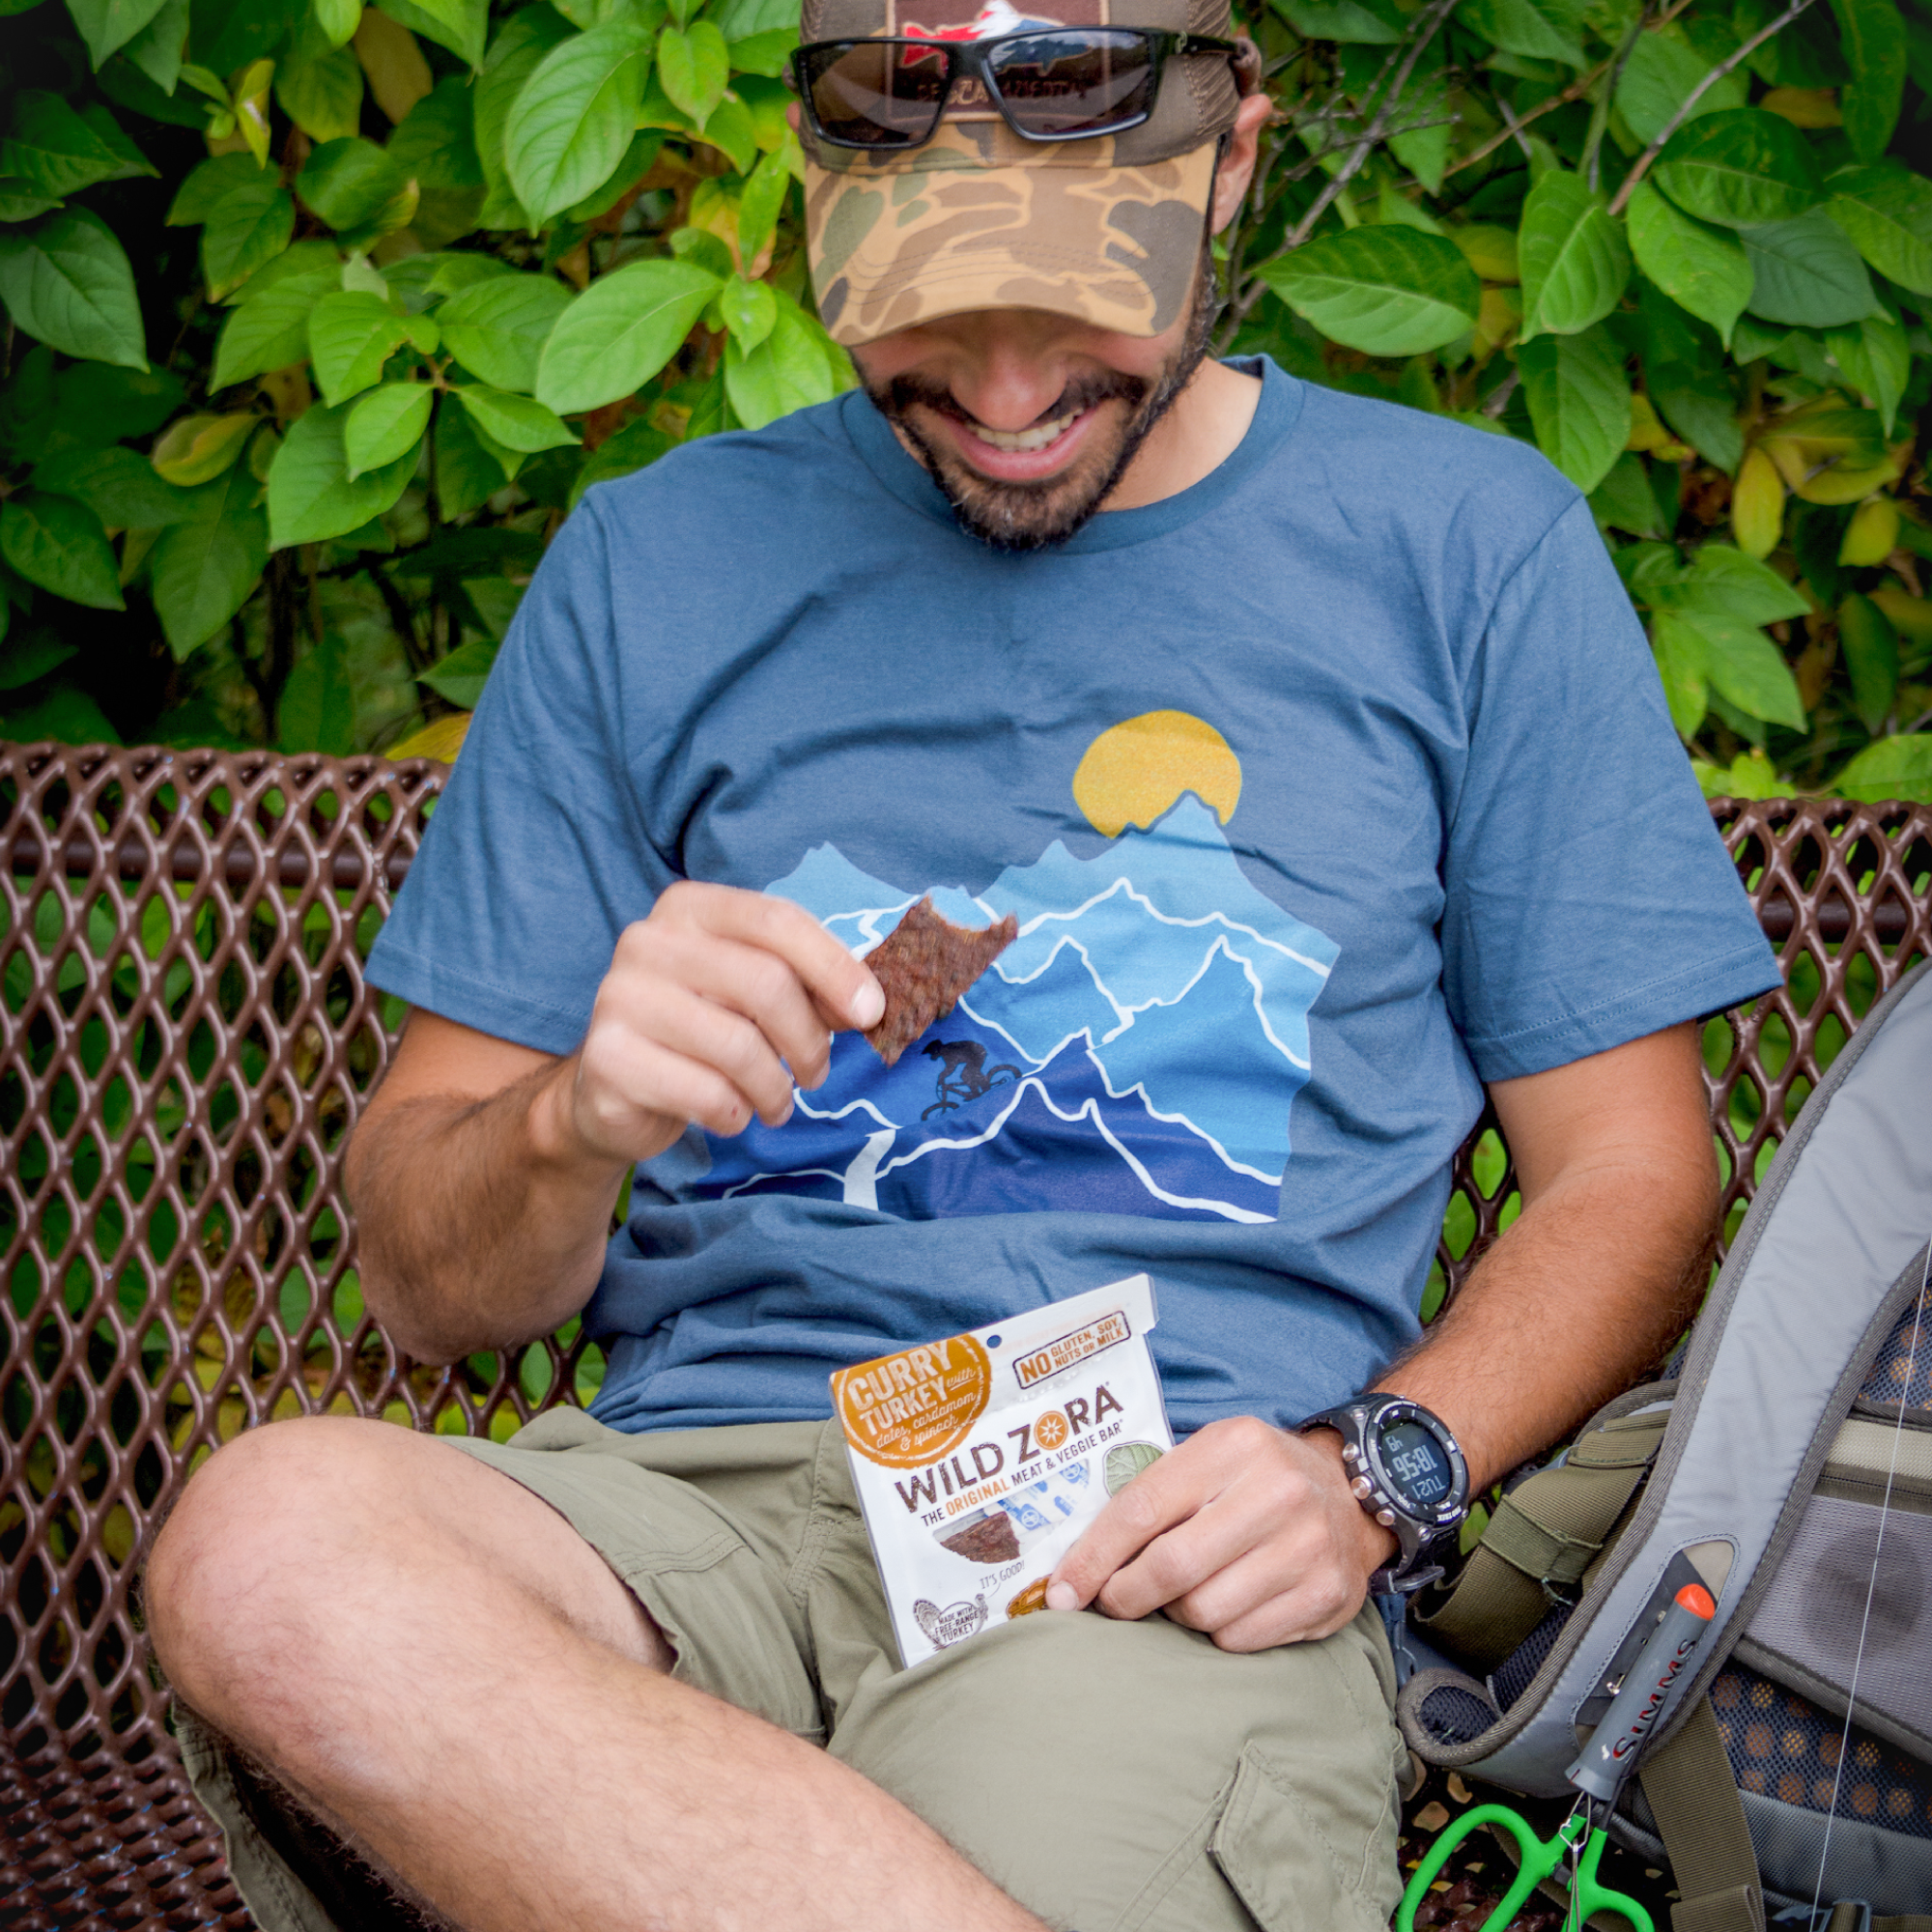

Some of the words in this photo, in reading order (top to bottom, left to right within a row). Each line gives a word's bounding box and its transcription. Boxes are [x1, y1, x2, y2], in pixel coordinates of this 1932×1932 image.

[1054, 1348, 1082, 1368] NUTS
[1083, 1342, 1095, 1353] OR
[1097, 1326, 1123, 1347] MILK
[848, 1340, 952, 1411] CURRY
[1019, 1352, 1052, 1383] NO
[859, 1376, 948, 1436] TURKEY
[947, 1367, 977, 1388] with
[877, 1426, 911, 1449] dates,
[913, 1392, 977, 1430] cardamom
[895, 1441, 1004, 1514] WILD
[1008, 1384, 1123, 1464] ZORA
[900, 1436, 911, 1451] &
[915, 1414, 958, 1446] spinach
[921, 1508, 946, 1527] THE
[946, 1478, 1010, 1517] ORIGINAL
[1011, 1462, 1043, 1487] MEAT
[1046, 1457, 1056, 1470] &
[1056, 1435, 1098, 1463] VEGGIE
[1100, 1421, 1122, 1442] BAR
[1392, 1444, 1438, 1482] 18:56
[980, 1574, 998, 1589] IT'S
[999, 1560, 1025, 1581] GOOD!
[935, 1610, 979, 1635] FREE-RANGE
[938, 1612, 955, 1625] MADE
[957, 1605, 973, 1617] WITH
[942, 1622, 974, 1642] TURKEY
[1612, 1638, 1696, 1763] SIMMS
